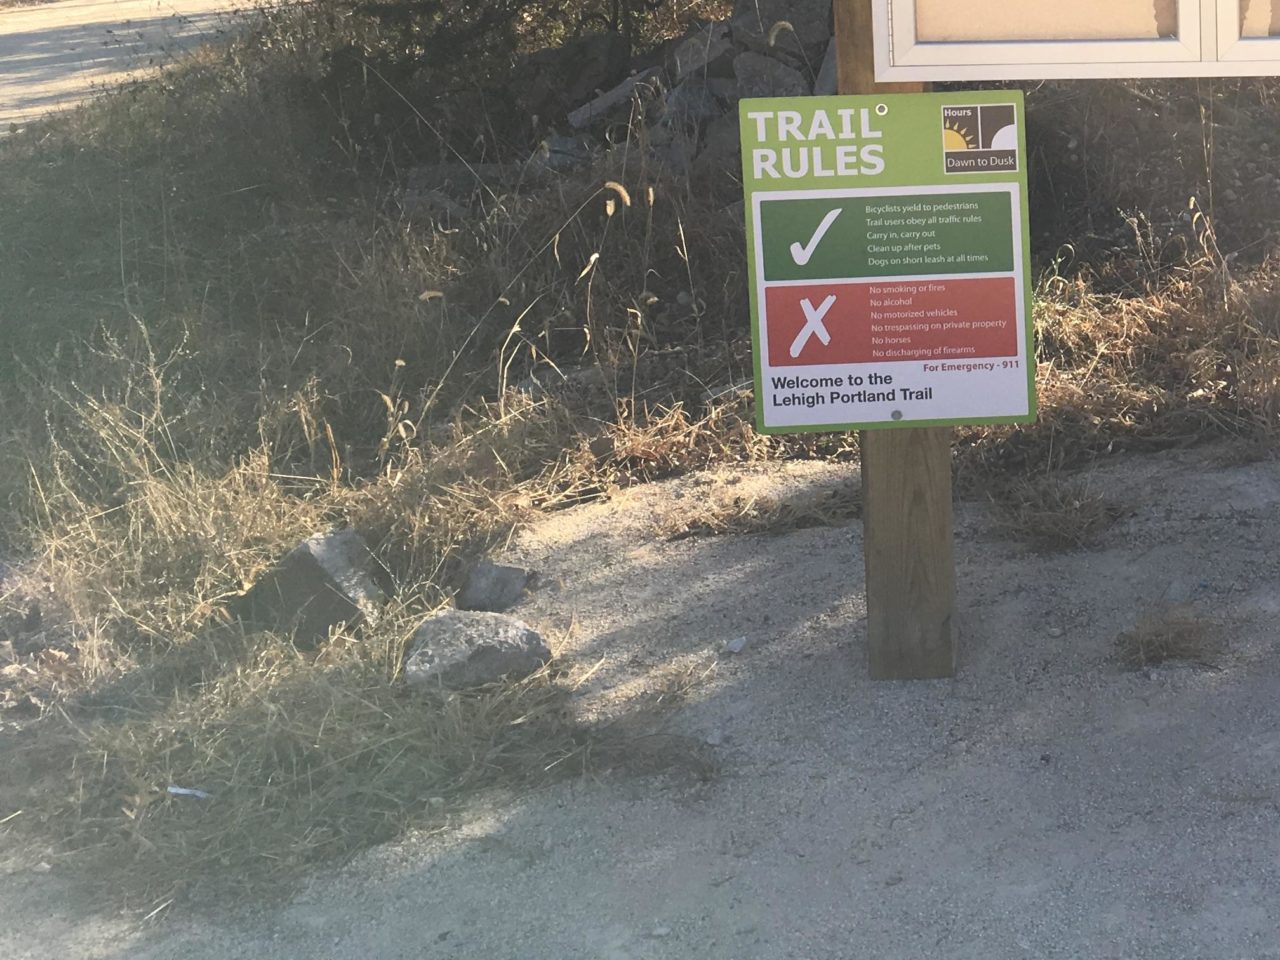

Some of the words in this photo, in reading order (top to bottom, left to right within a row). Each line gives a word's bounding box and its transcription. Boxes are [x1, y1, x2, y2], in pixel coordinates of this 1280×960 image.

[944, 109, 972, 117] Hours
[747, 108, 883, 142] TRAIL
[752, 144, 886, 179] RULES
[947, 158, 975, 167] Dawn
[977, 158, 988, 166] to
[990, 156, 1015, 166] Dusk
[865, 204, 901, 215] Bicyclists
[902, 203, 921, 214] yield
[922, 204, 932, 212] to
[932, 202, 979, 213] pedestrians
[865, 218, 883, 227] Trail
[884, 218, 905, 226] users
[905, 217, 926, 226] obey
[927, 215, 937, 224] all
[938, 214, 961, 224] traffic
[962, 214, 983, 224] rules
[866, 231, 888, 241] Carry
[889, 231, 899, 239] in,
[900, 230, 921, 240] carry
[921, 230, 936, 238] out
[867, 243, 890, 253] Clean
[890, 244, 902, 253] up
[903, 242, 922, 251] after
[923, 242, 941, 252] pets
[868, 256, 889, 267] Dogs
[890, 257, 901, 265] on
[902, 256, 923, 265] short
[924, 255, 945, 264] leash
[946, 255, 955, 263] at
[955, 253, 966, 262] all
[966, 253, 989, 262] times
[869, 286, 881, 295] No
[882, 285, 917, 295] smoking
[918, 285, 928, 293] or
[928, 283, 946, 292] fires
[870, 299, 881, 307] No
[883, 297, 912, 306] alcohol
[870, 311, 883, 320] No
[883, 309, 925, 319] motorized
[925, 308, 958, 318] vehicles
[871, 324, 884, 332] No
[884, 322, 929, 332] trespassing
[930, 322, 942, 330] on
[943, 320, 970, 330] private
[972, 319, 1007, 330] property
[871, 336, 884, 345] No
[885, 335, 912, 344] horses
[872, 349, 884, 358] No
[885, 347, 932, 358] discharging
[933, 346, 943, 356] of
[943, 345, 976, 355] firearms
[923, 363, 940, 372] For
[941, 361, 995, 373] Emergency
[1002, 360, 1019, 369] 911
[771, 375, 844, 390] Welcome
[848, 374, 864, 387] to
[868, 372, 893, 386] the
[772, 392, 825, 408] Lehigh
[830, 388, 896, 405] Portland
[899, 386, 933, 401] Trail
